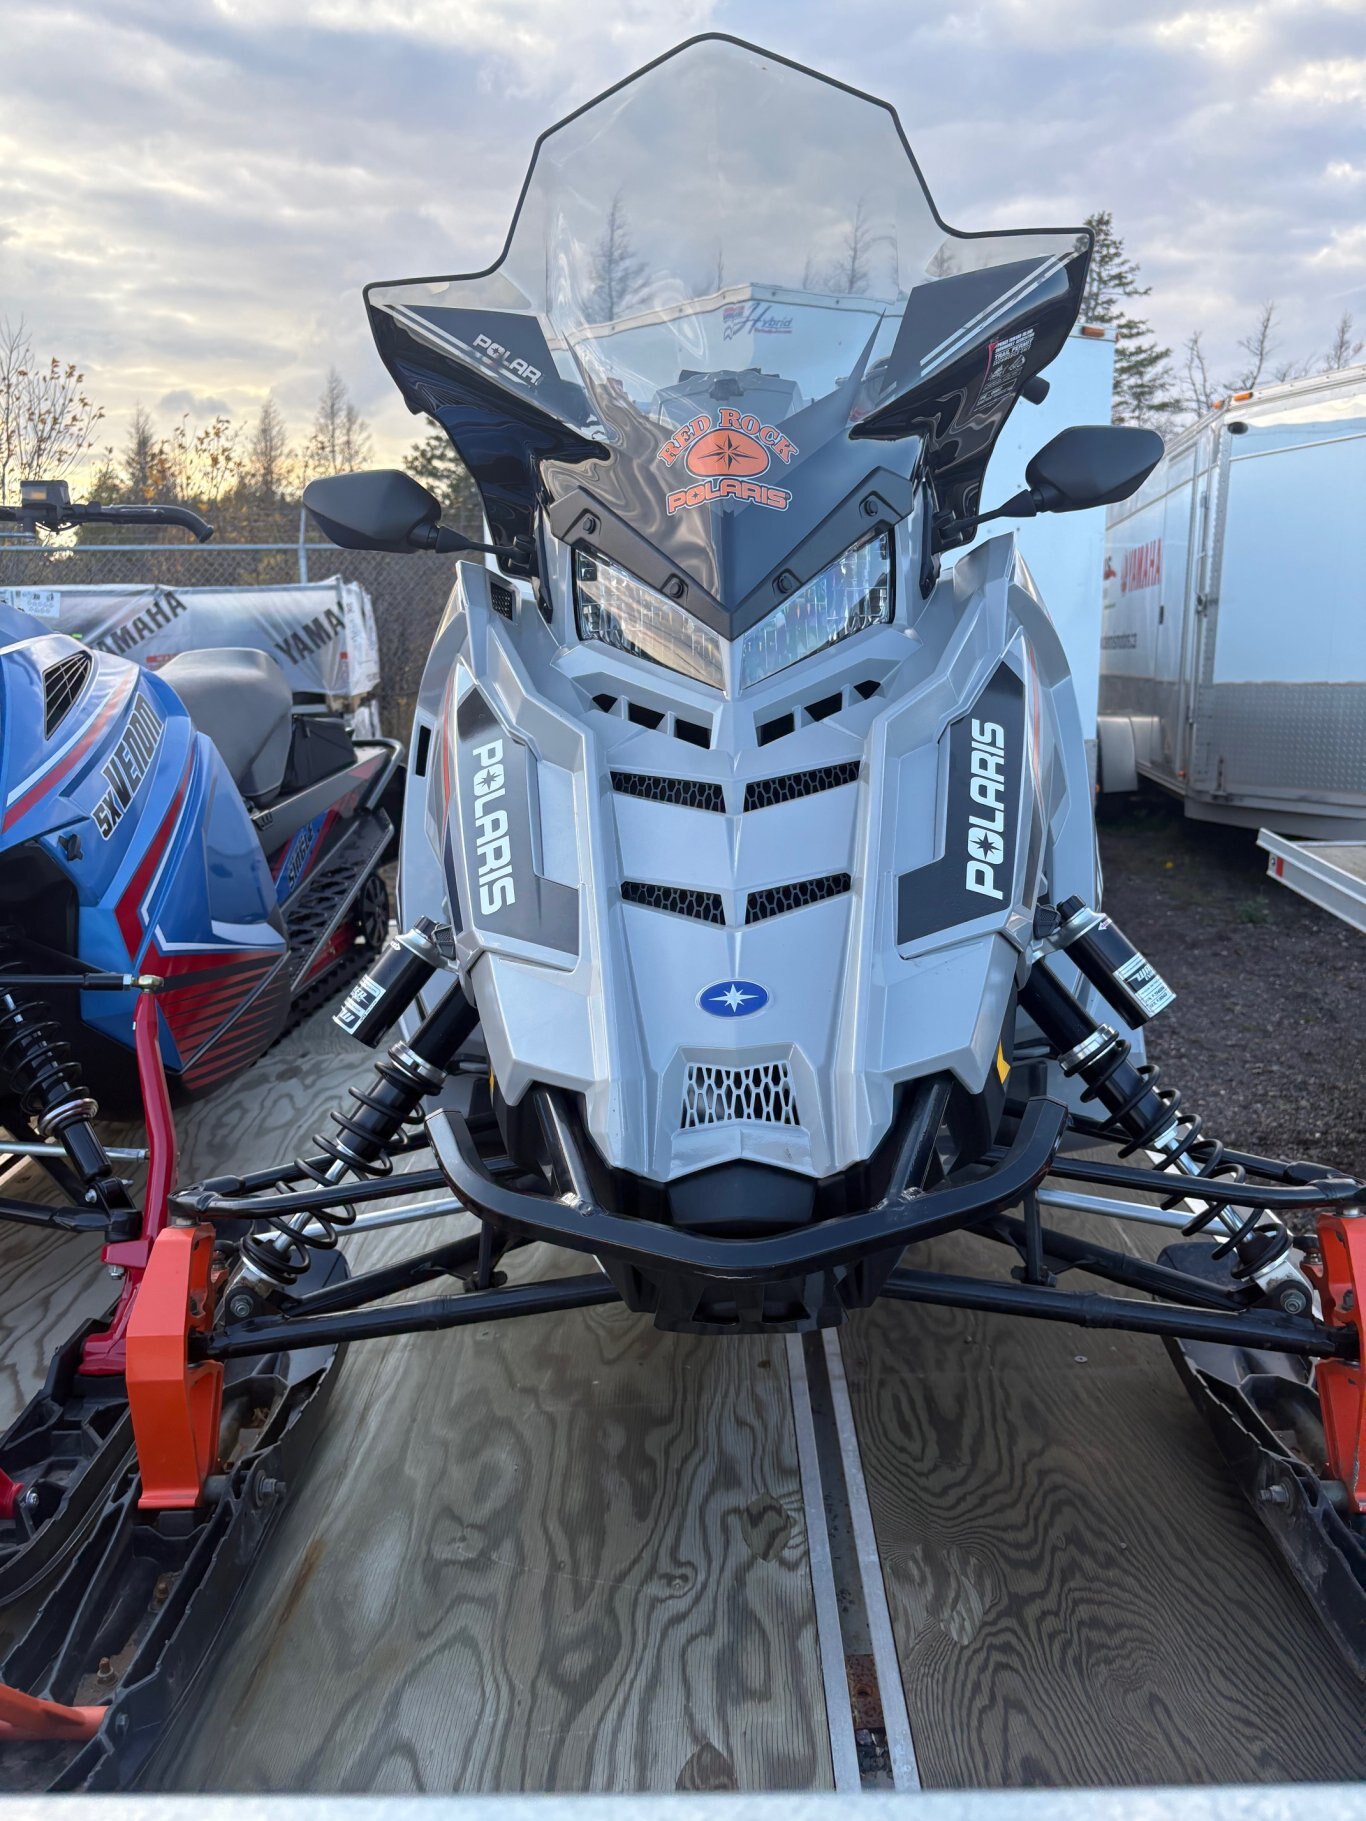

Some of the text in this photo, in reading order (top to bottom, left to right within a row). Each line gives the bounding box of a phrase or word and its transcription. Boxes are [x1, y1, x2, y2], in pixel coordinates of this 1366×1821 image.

[657, 407, 799, 467] RED ROCK
[666, 477, 792, 515] POLARIS
[92, 591, 188, 655] AMAHA
[274, 600, 346, 665] YAMA
[473, 739, 516, 916] POLARIS
[966, 718, 1004, 900] POLARIS
